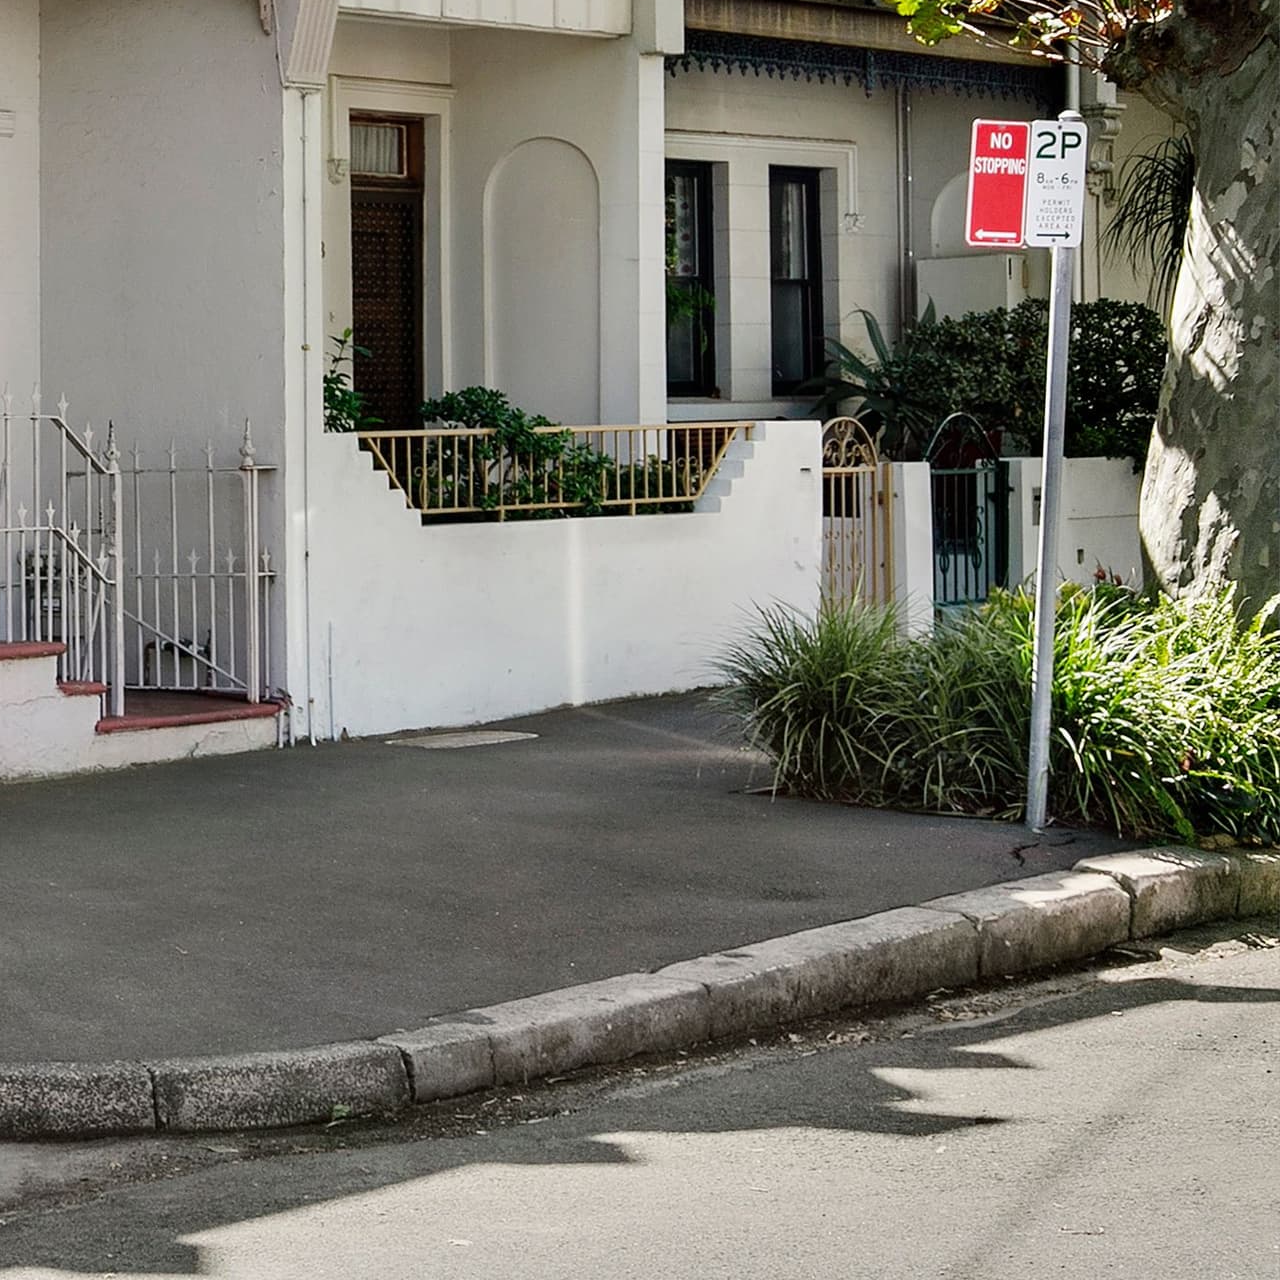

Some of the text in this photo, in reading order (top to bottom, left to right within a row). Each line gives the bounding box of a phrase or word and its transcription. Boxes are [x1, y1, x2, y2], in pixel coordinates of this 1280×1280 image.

[990, 132, 1013, 150] NO
[1036, 131, 1082, 159] 2P
[974, 156, 1026, 175] STOPPING
